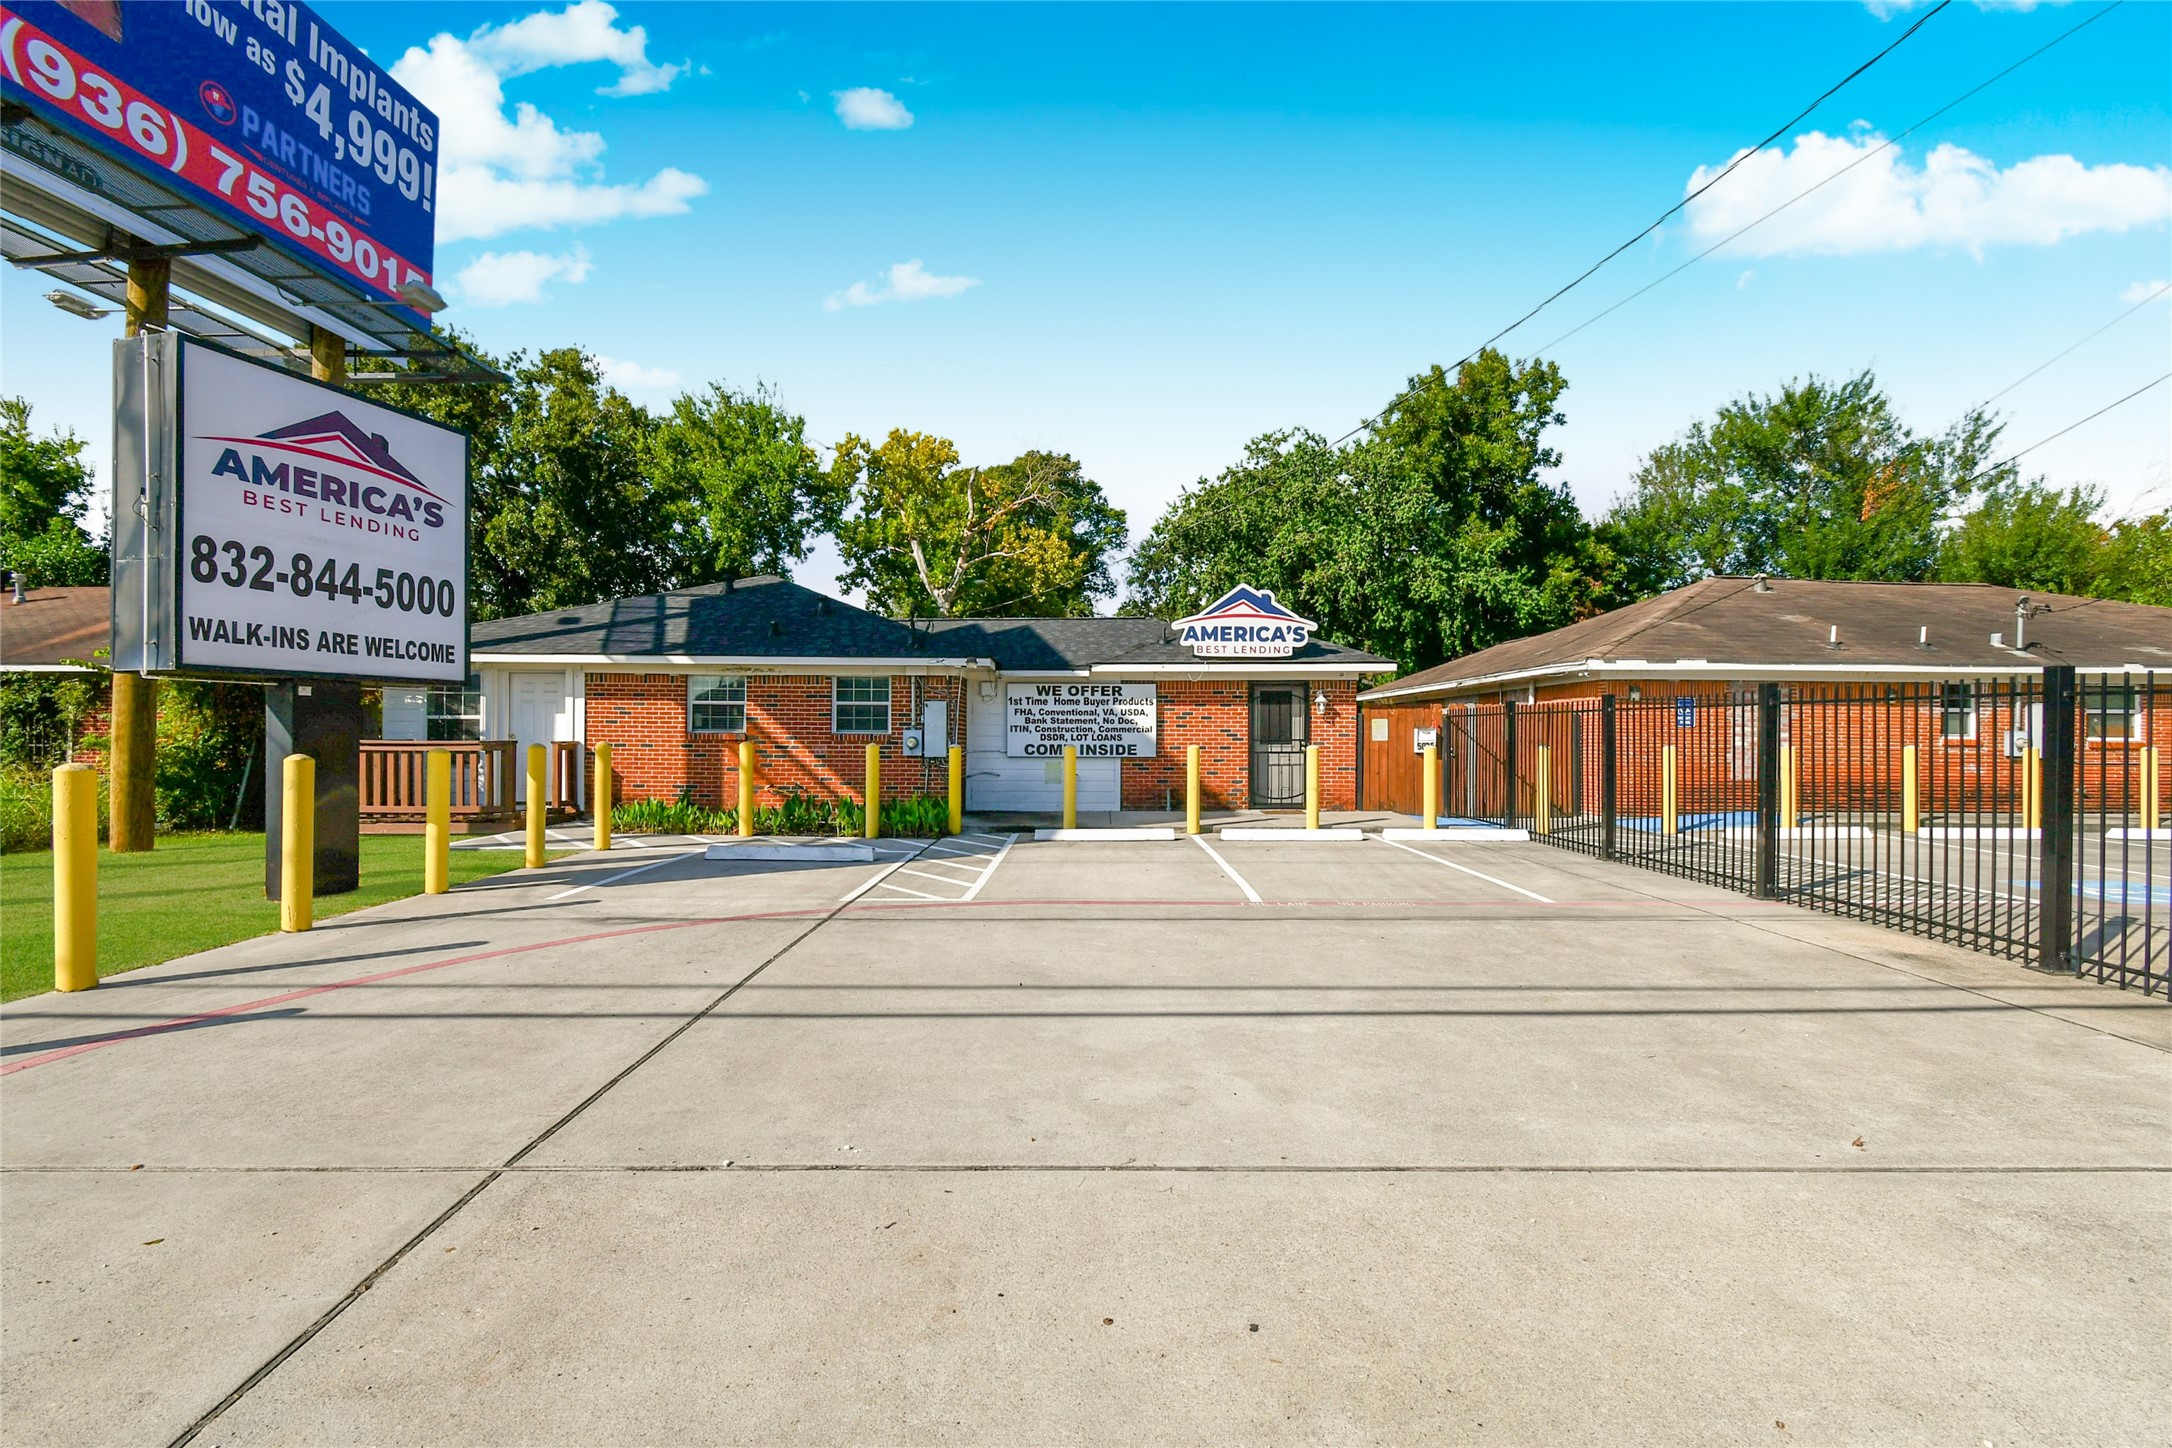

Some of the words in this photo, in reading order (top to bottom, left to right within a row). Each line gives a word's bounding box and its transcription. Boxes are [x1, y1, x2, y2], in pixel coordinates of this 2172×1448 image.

[309, 21, 434, 152] Implants
[1, 17, 188, 174] (936)
[246, 36, 276, 75] as
[285, 58, 433, 213] $4,999!
[243, 104, 370, 216] PARTNERS
[211, 448, 445, 528] AMERICA'S
[243, 490, 308, 517] BEST
[321, 508, 420, 541] LENDING
[190, 535, 455, 617] 832-844-5000
[189, 616, 310, 650] WALK-INS
[316, 631, 358, 655] ARE
[365, 636, 456, 664] WELCOME
[1183, 625, 1306, 642] AMERICA'S
[1196, 645, 1228, 654] BEST
[1233, 645, 1291, 654] LENDING
[1036, 685, 1062, 696] WE
[1068, 685, 1123, 697] OFFER
[1008, 697, 1022, 706] 1st
[1025, 697, 1048, 706] Time
[1054, 697, 1082, 706] Home
[1084, 697, 1110, 707] Buyer
[1113, 697, 1154, 706] Products
[1014, 708, 1036, 717] FHA,
[1038, 708, 1100, 717] Conventional,
[1103, 708, 1118, 717] VA,
[1121, 708, 1149, 717] USDA,
[1010, 725, 1032, 734] ITIN,
[1034, 725, 1096, 734] Construction,
[1099, 725, 1152, 733] Commercial
[1025, 717, 1047, 725] Bank
[1050, 717, 1100, 726] Statement,
[1103, 717, 1115, 725] No
[1118, 717, 1138, 726] Doc,
[1091, 734, 1122, 742] LOANS
[1024, 744, 1068, 756] COM
[1080, 744, 1137, 756] INSIDE
